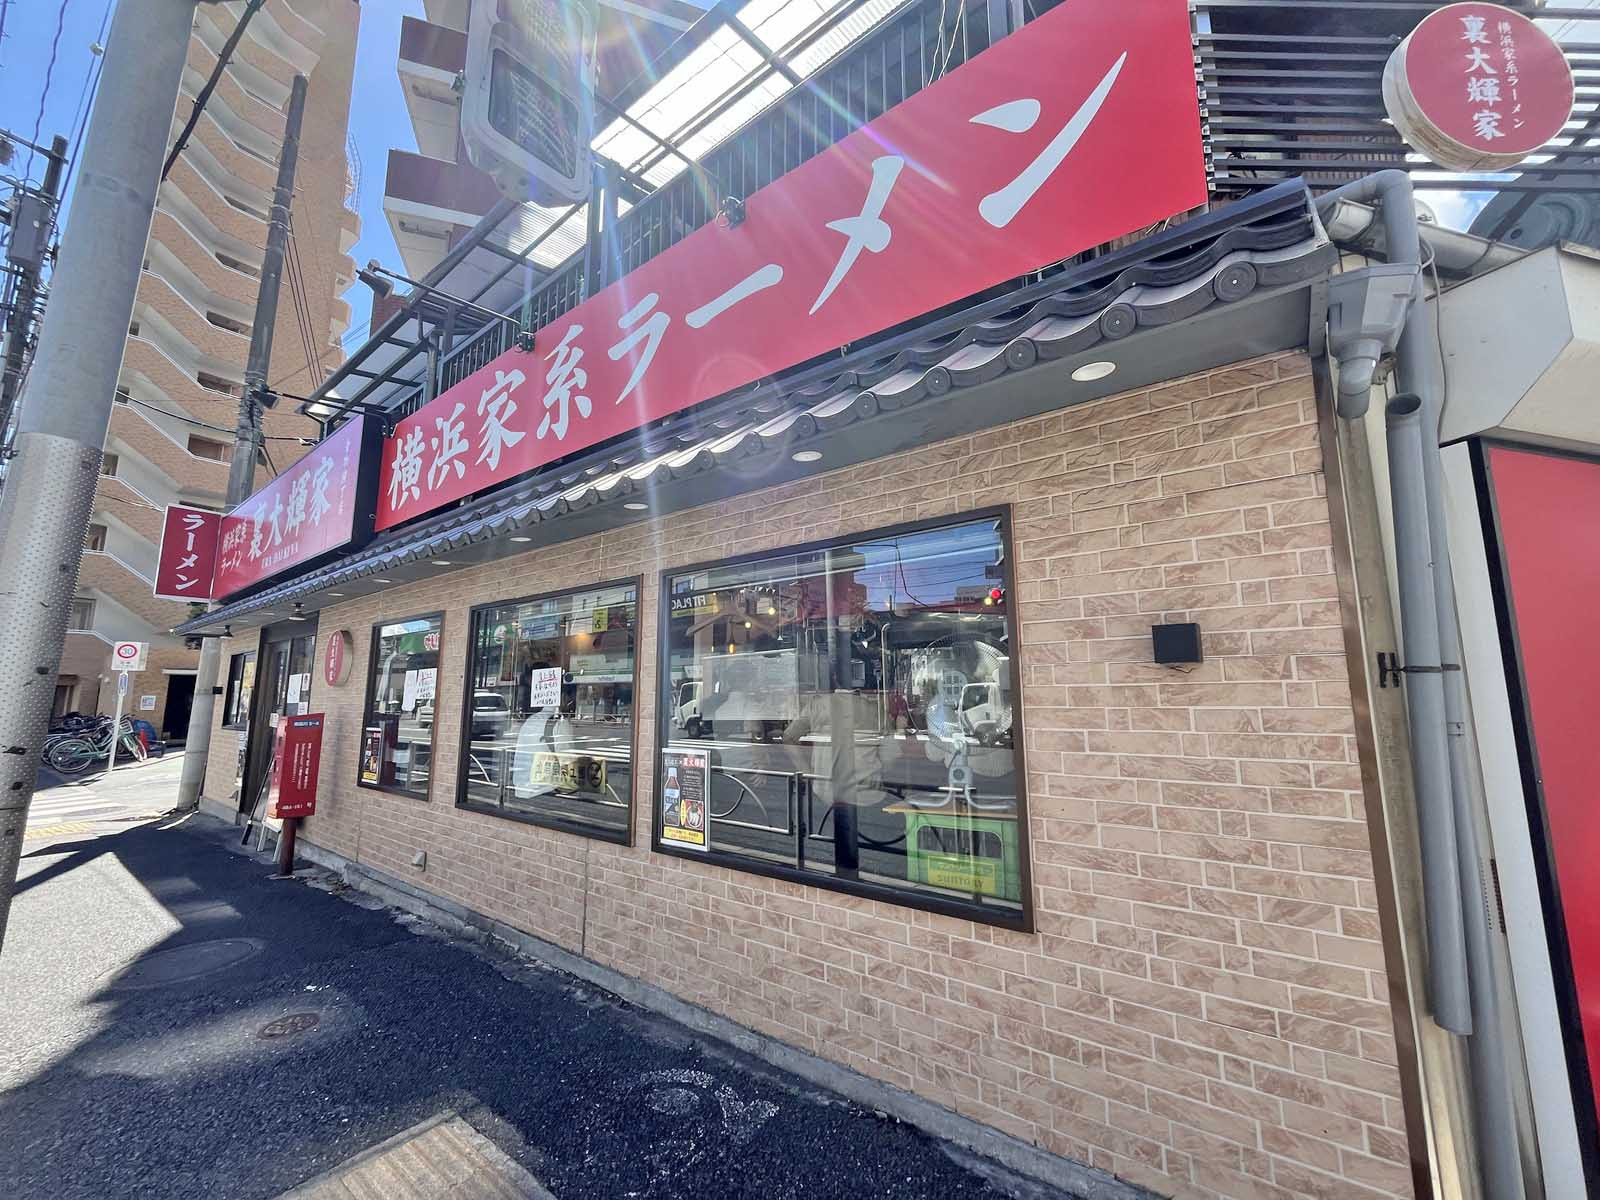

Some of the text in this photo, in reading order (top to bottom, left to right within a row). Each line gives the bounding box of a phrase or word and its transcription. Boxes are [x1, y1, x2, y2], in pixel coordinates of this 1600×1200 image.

[1459, 15, 1506, 141] 裏大輝家
[1497, 20, 1525, 130] 横浜家系ラーメン
[387, 50, 1128, 512] 横浜家系ラーメン
[175, 513, 205, 591] ラーメン
